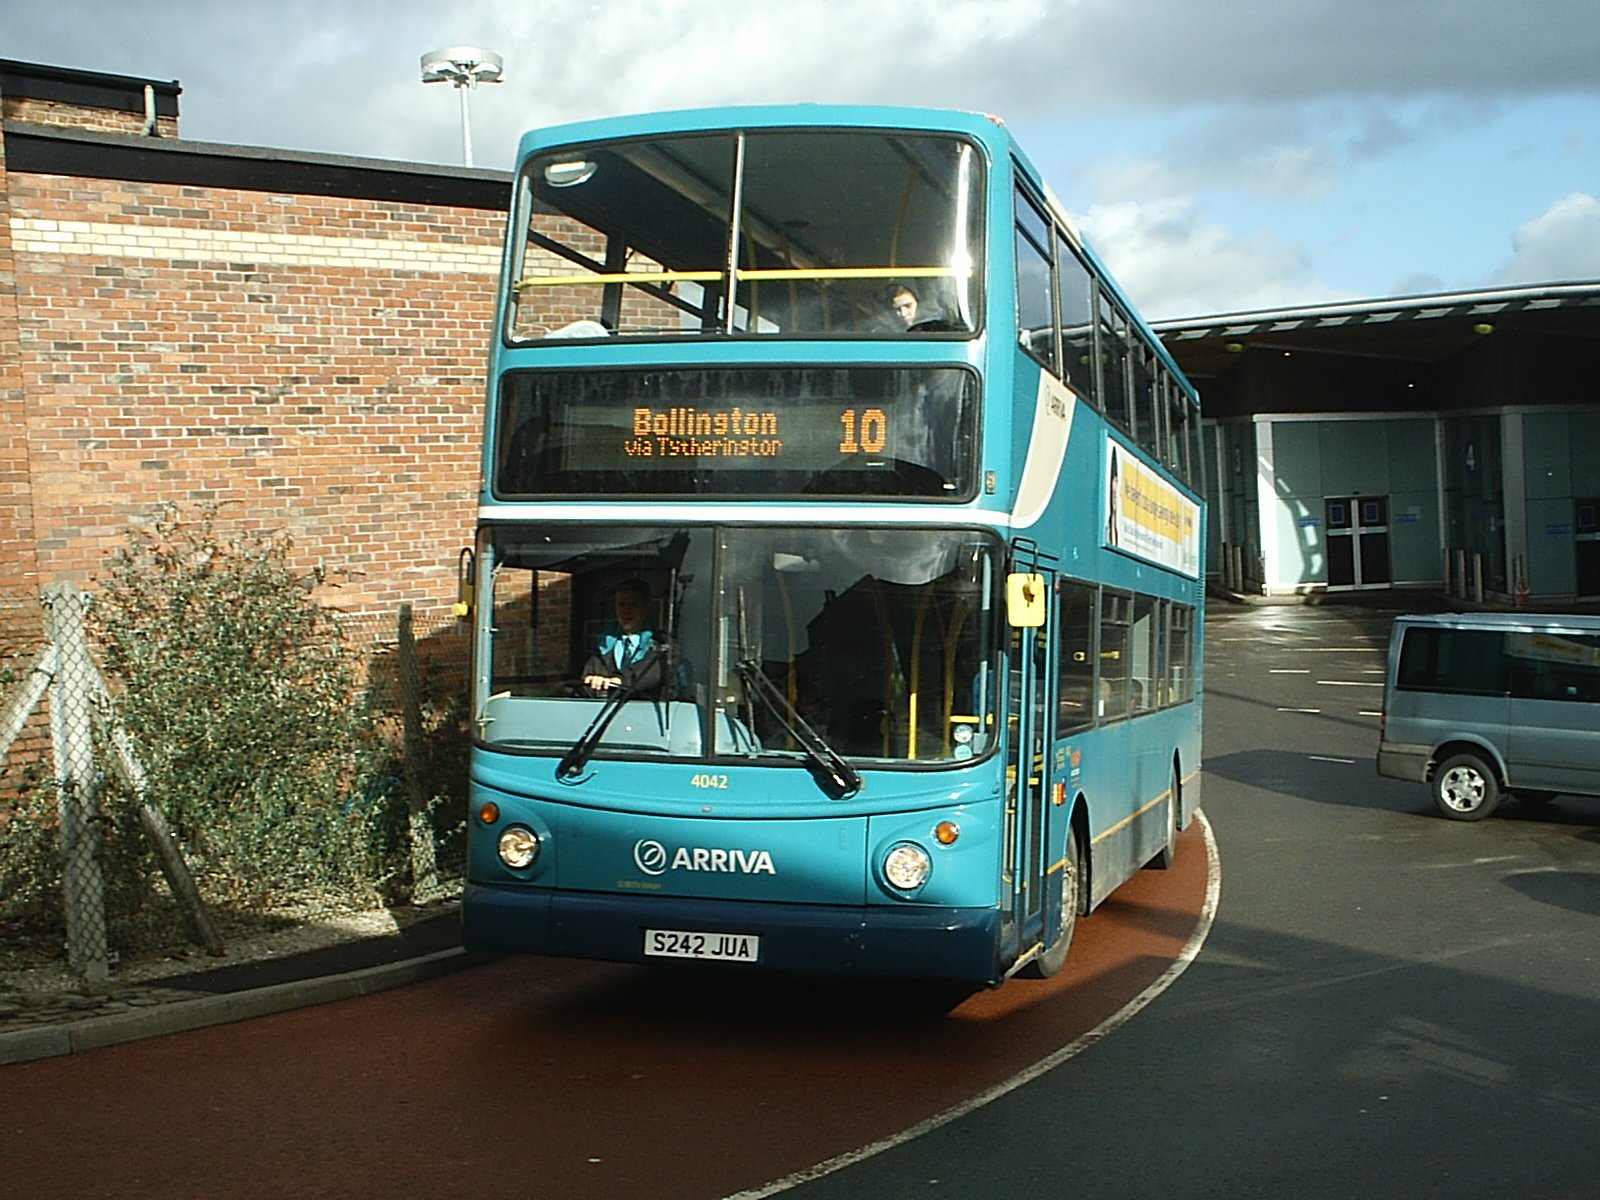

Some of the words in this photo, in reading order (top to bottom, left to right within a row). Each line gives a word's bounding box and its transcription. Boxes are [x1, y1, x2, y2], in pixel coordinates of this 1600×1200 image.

[633, 408, 779, 436] Bollington
[839, 409, 887, 453] 10
[624, 438, 653, 456] via
[1465, 443, 1476, 471] 4
[690, 774, 729, 789] 4042
[671, 847, 776, 875] ARRIVA
[653, 932, 706, 955] S242
[711, 936, 750, 958] JUA
